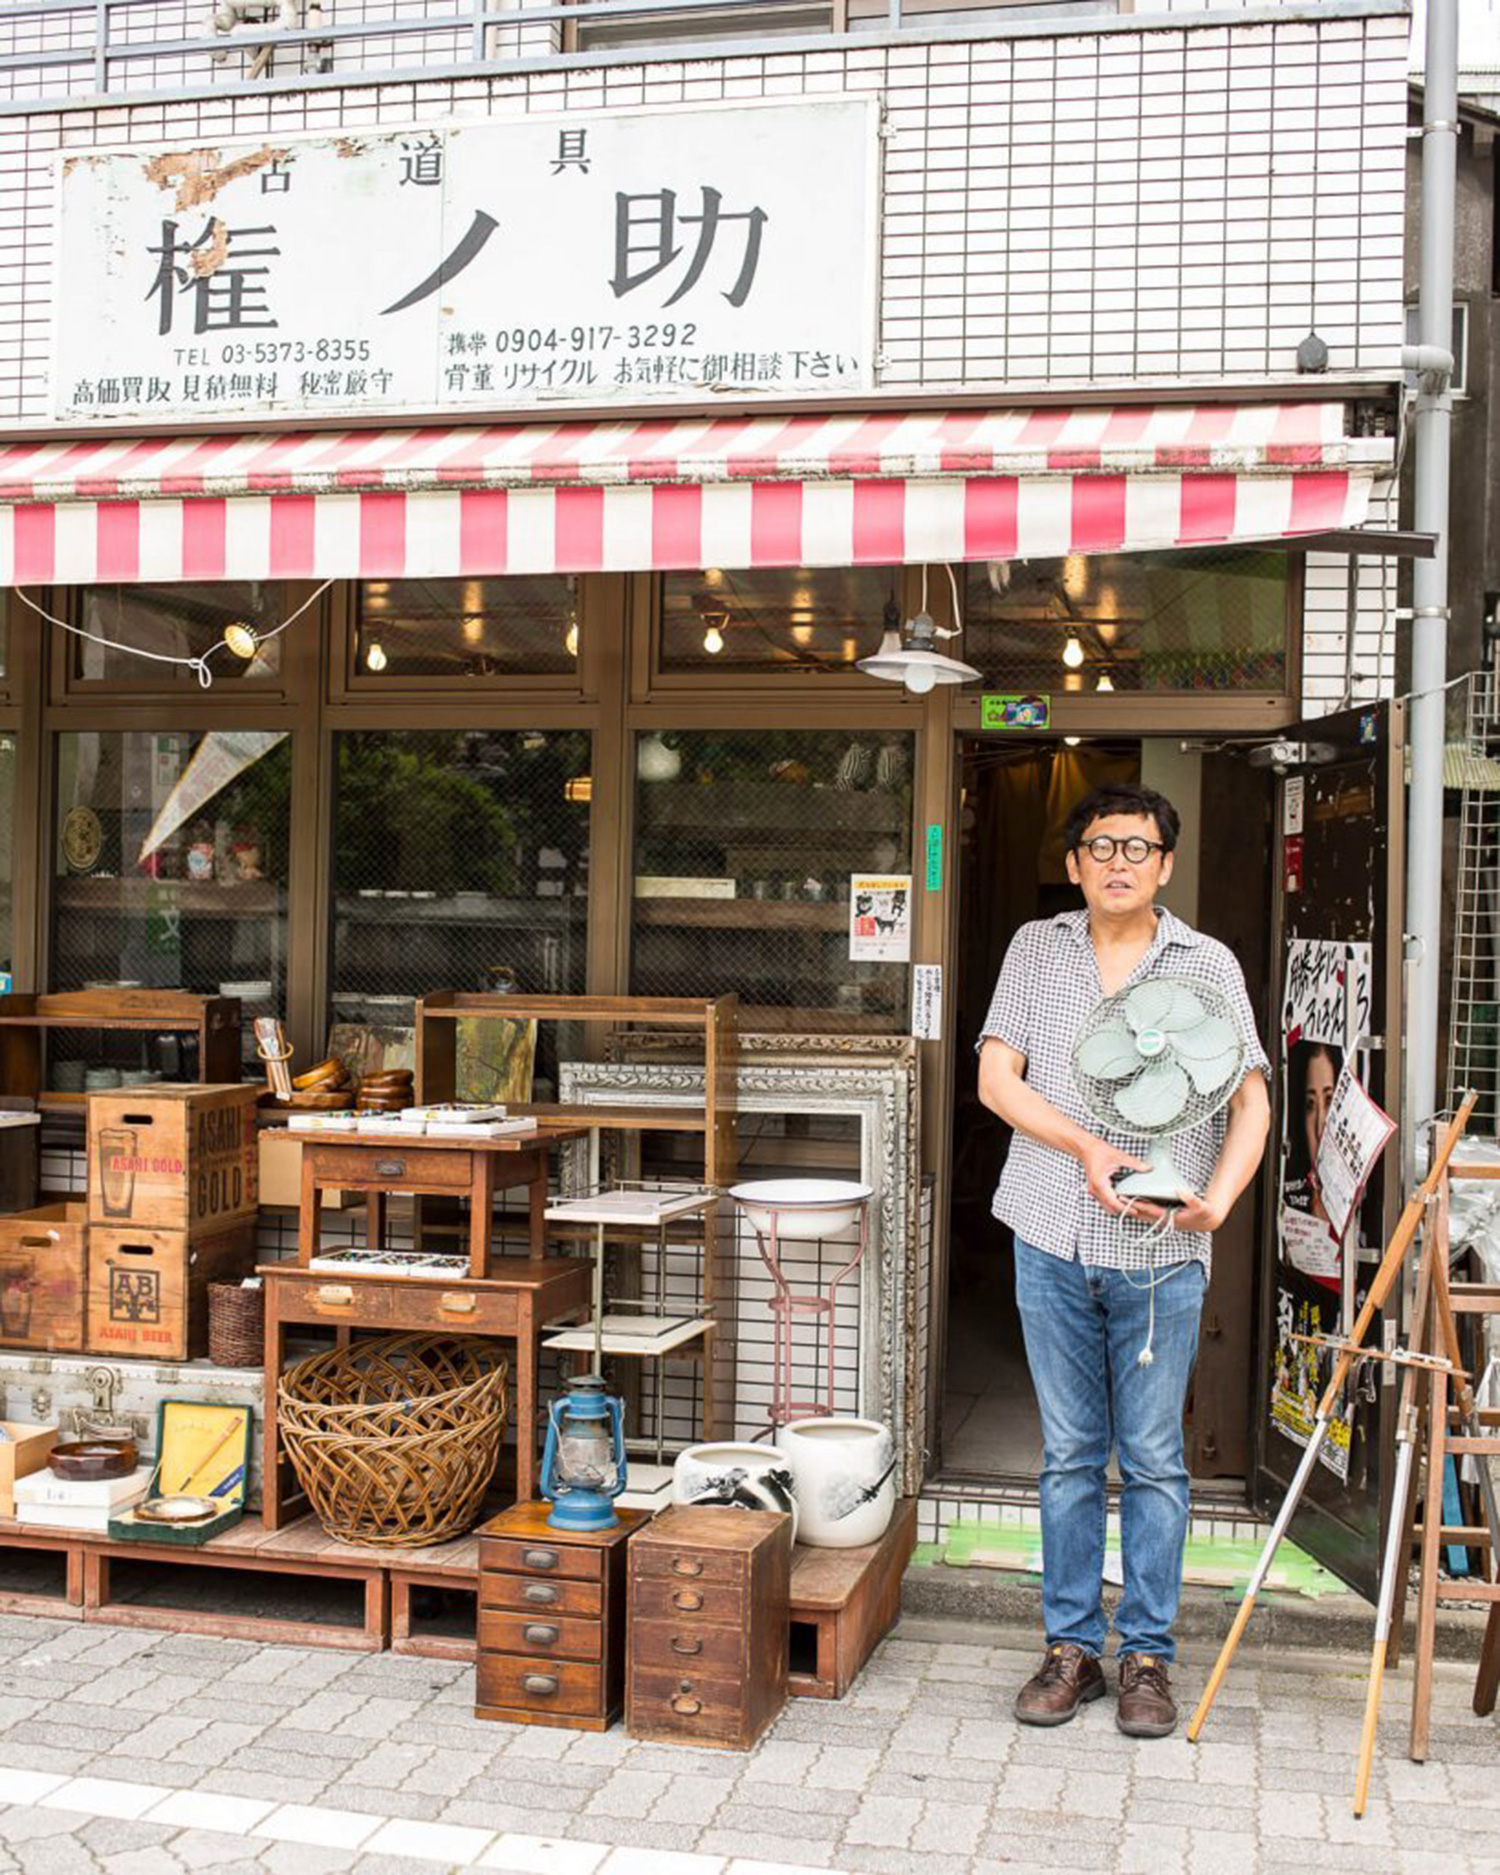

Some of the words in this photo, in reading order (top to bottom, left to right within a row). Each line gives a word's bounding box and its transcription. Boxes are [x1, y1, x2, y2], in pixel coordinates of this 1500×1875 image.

[144, 185, 769, 336] 権ノ助
[173, 347, 211, 367] TEL
[221, 338, 370, 365] 03-5373-8355
[447, 331, 487, 357] 携帯
[495, 322, 697, 353] 0904-917-3292
[73, 376, 171, 406] 高価買取
[182, 370, 278, 402] 見積無料
[300, 367, 393, 396] 秘密厳守
[504, 358, 598, 391] リサイクル
[197, 1105, 241, 1156] ASAHI
[112, 1154, 148, 1173] ASAHI
[152, 1157, 183, 1173] GOLD
[197, 1165, 242, 1218] GOLD
[142, 1328, 173, 1343] BEER
